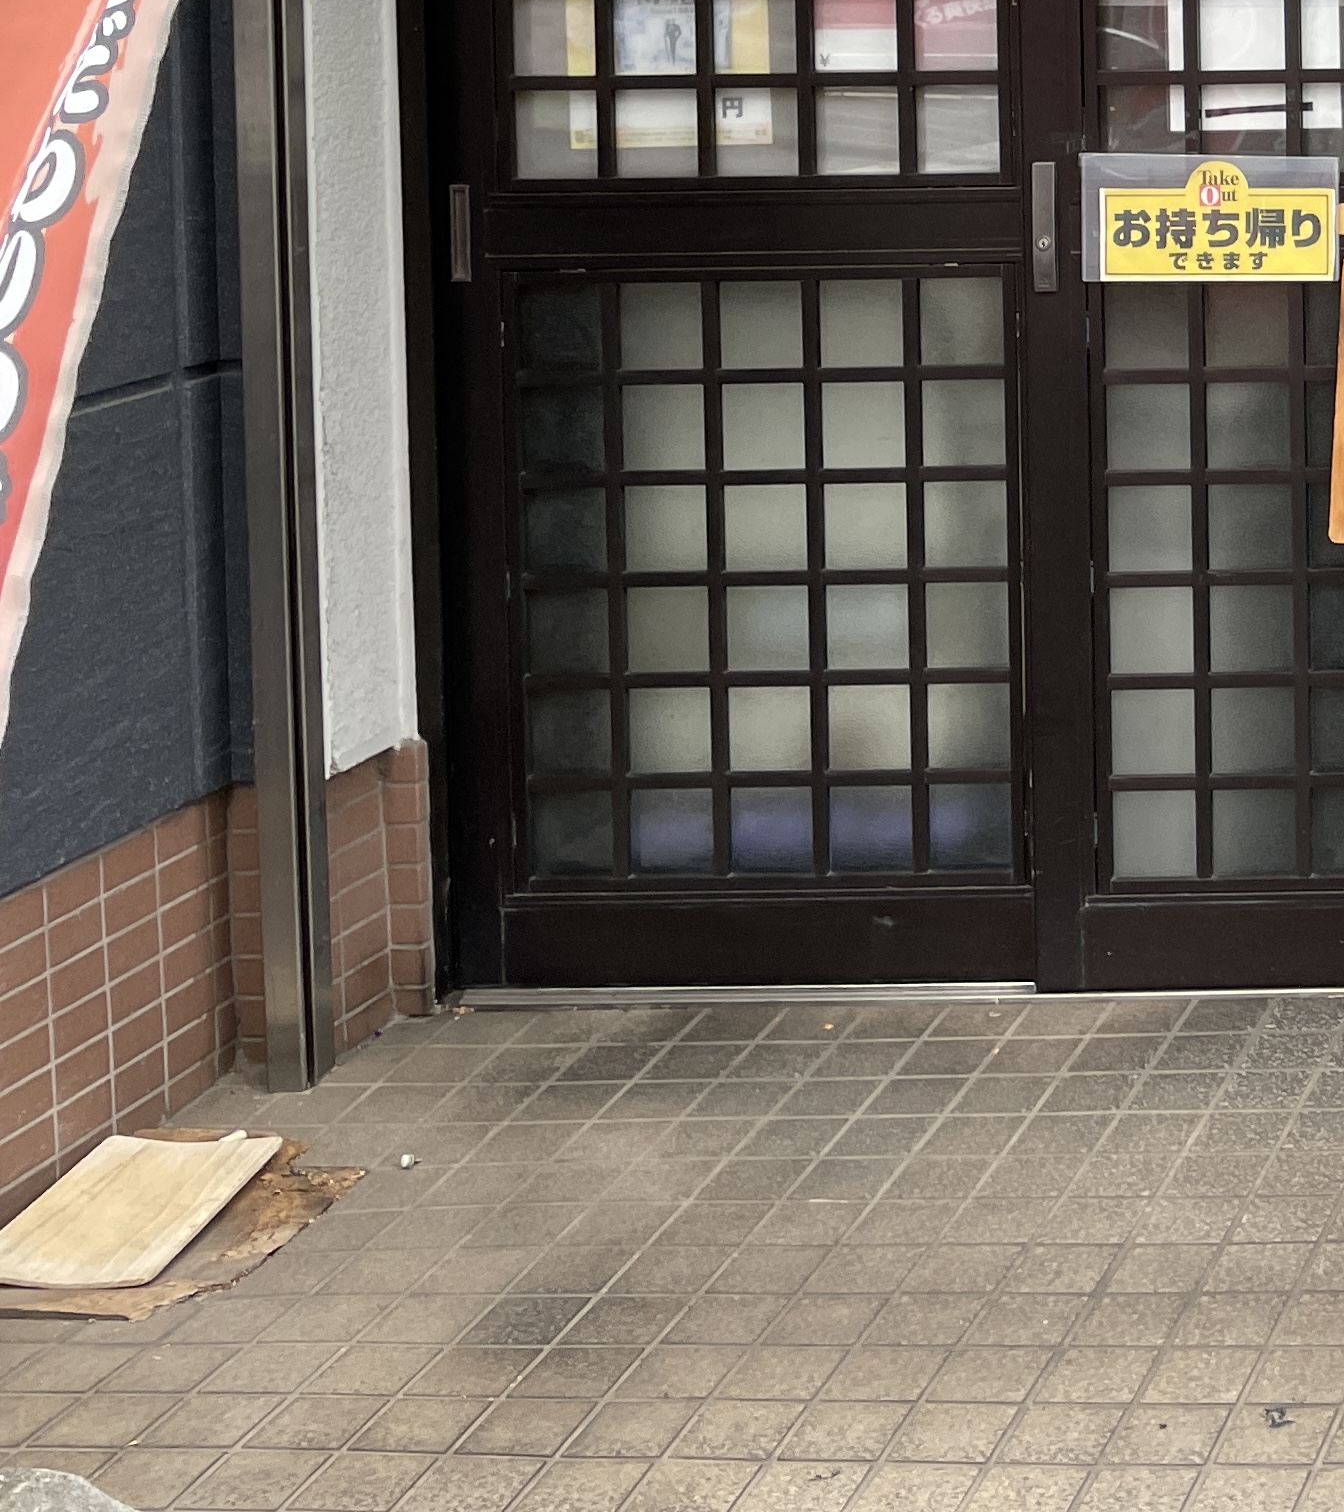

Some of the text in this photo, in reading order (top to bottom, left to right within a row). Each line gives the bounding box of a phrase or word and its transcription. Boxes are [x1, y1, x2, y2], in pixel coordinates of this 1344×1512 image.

[722, 97, 744, 118] 円
[1197, 170, 1240, 186] Take
[1200, 186, 1238, 205] Out
[1112, 208, 1323, 250] お持ち帰り
[1169, 252, 1269, 271] できます
